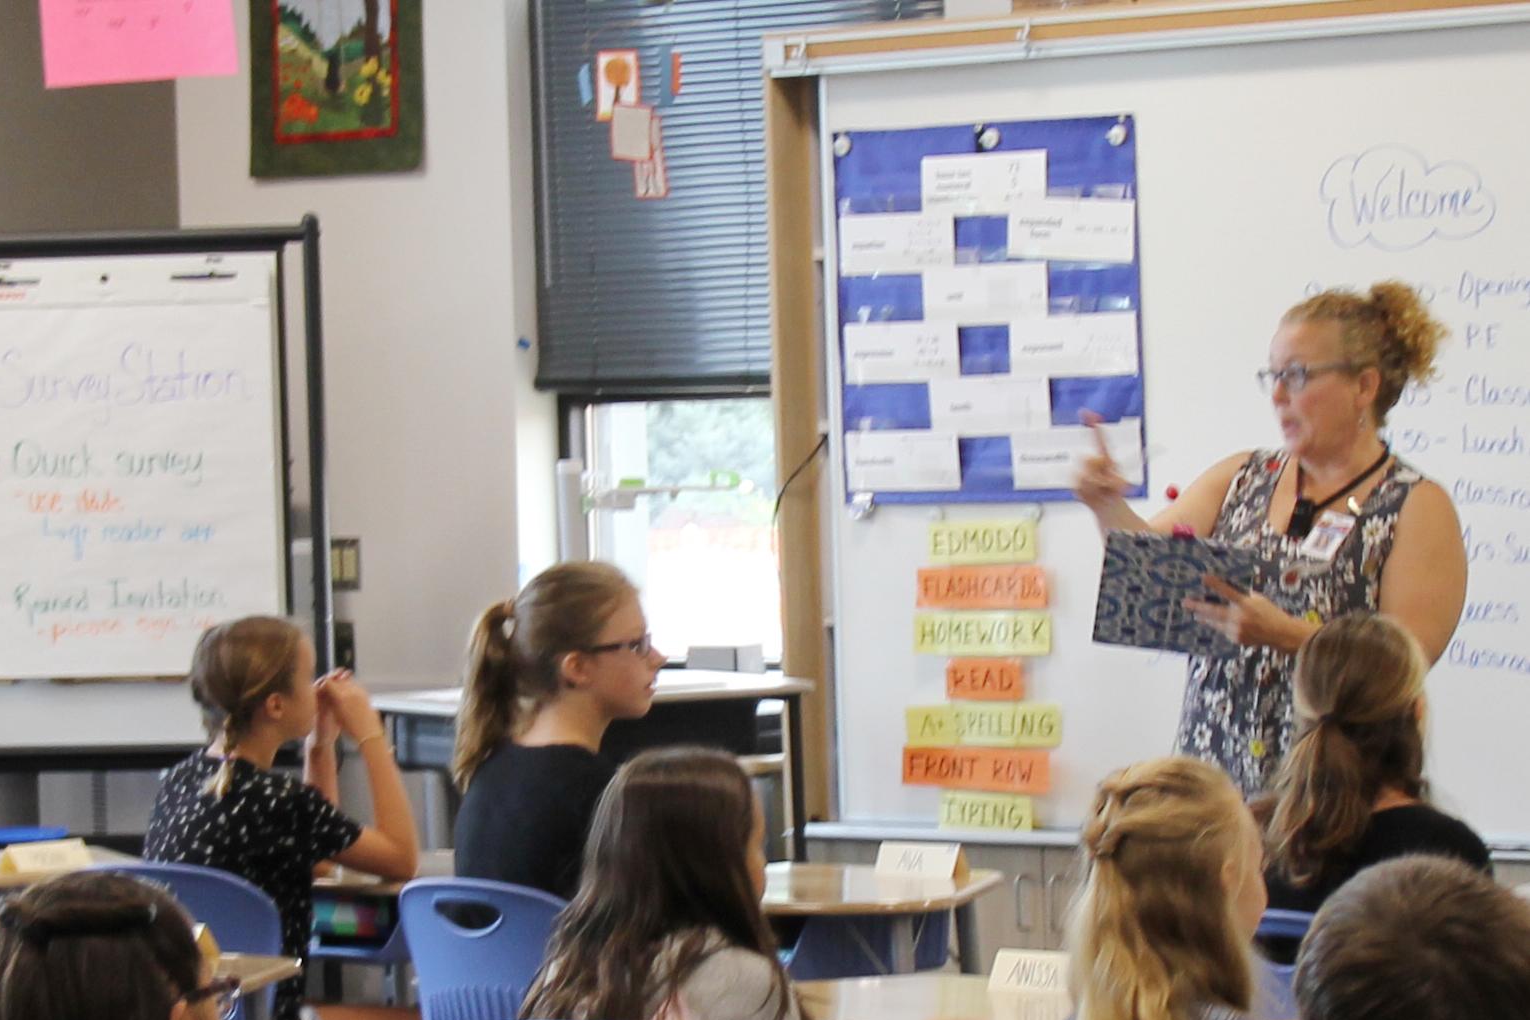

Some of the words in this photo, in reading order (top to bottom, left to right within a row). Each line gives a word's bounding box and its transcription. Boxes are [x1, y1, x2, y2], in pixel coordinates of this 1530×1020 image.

[1350, 164, 1485, 226] Welcome
[114, 342, 253, 406] Station
[12, 438, 94, 479] Quick
[115, 448, 205, 488] survey
[932, 525, 1028, 556] EDMODO
[922, 573, 1043, 600] FLASHCARDS
[1462, 601, 1520, 626] ecess
[920, 618, 1046, 646] HOMEWORK
[950, 667, 1014, 692] READ
[955, 711, 1055, 738] SPELLING
[909, 753, 980, 779] FRONT
[992, 758, 1034, 784] ROW
[942, 797, 1024, 830] TYPING
